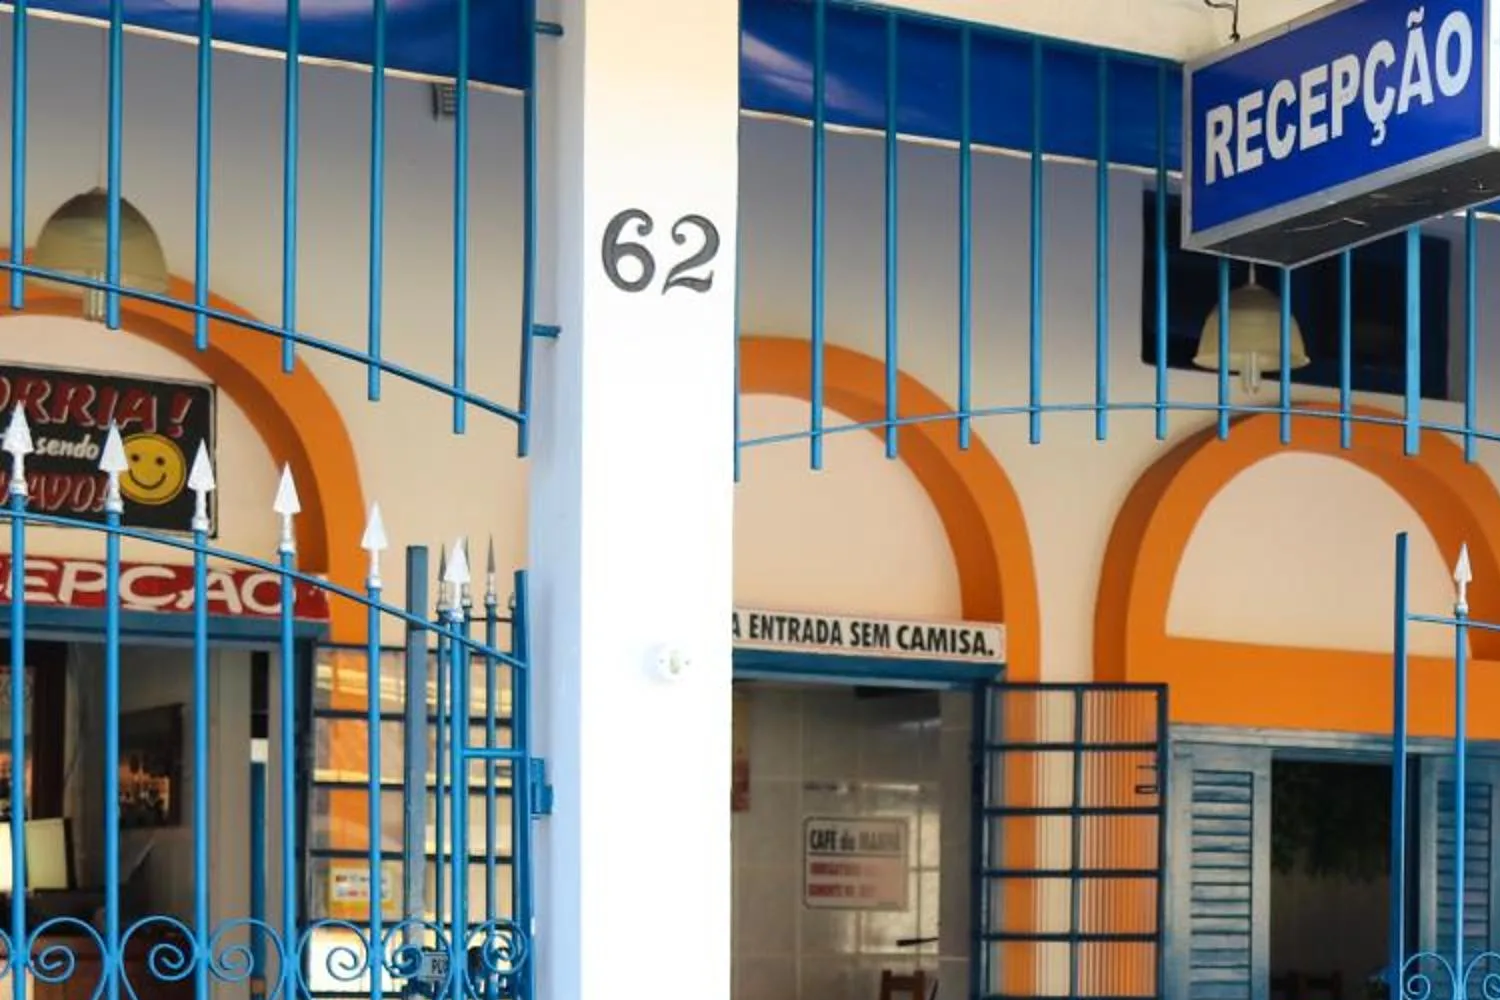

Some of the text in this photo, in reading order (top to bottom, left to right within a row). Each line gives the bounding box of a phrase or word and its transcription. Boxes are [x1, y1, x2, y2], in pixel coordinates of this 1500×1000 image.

[1204, 6, 1474, 186] RECEPÇÃO
[601, 208, 720, 296] 62
[36, 433, 99, 461] sendo
[749, 613, 842, 645] ENTRADA
[850, 621, 890, 649] SEM
[896, 624, 994, 657] CAMISA.
